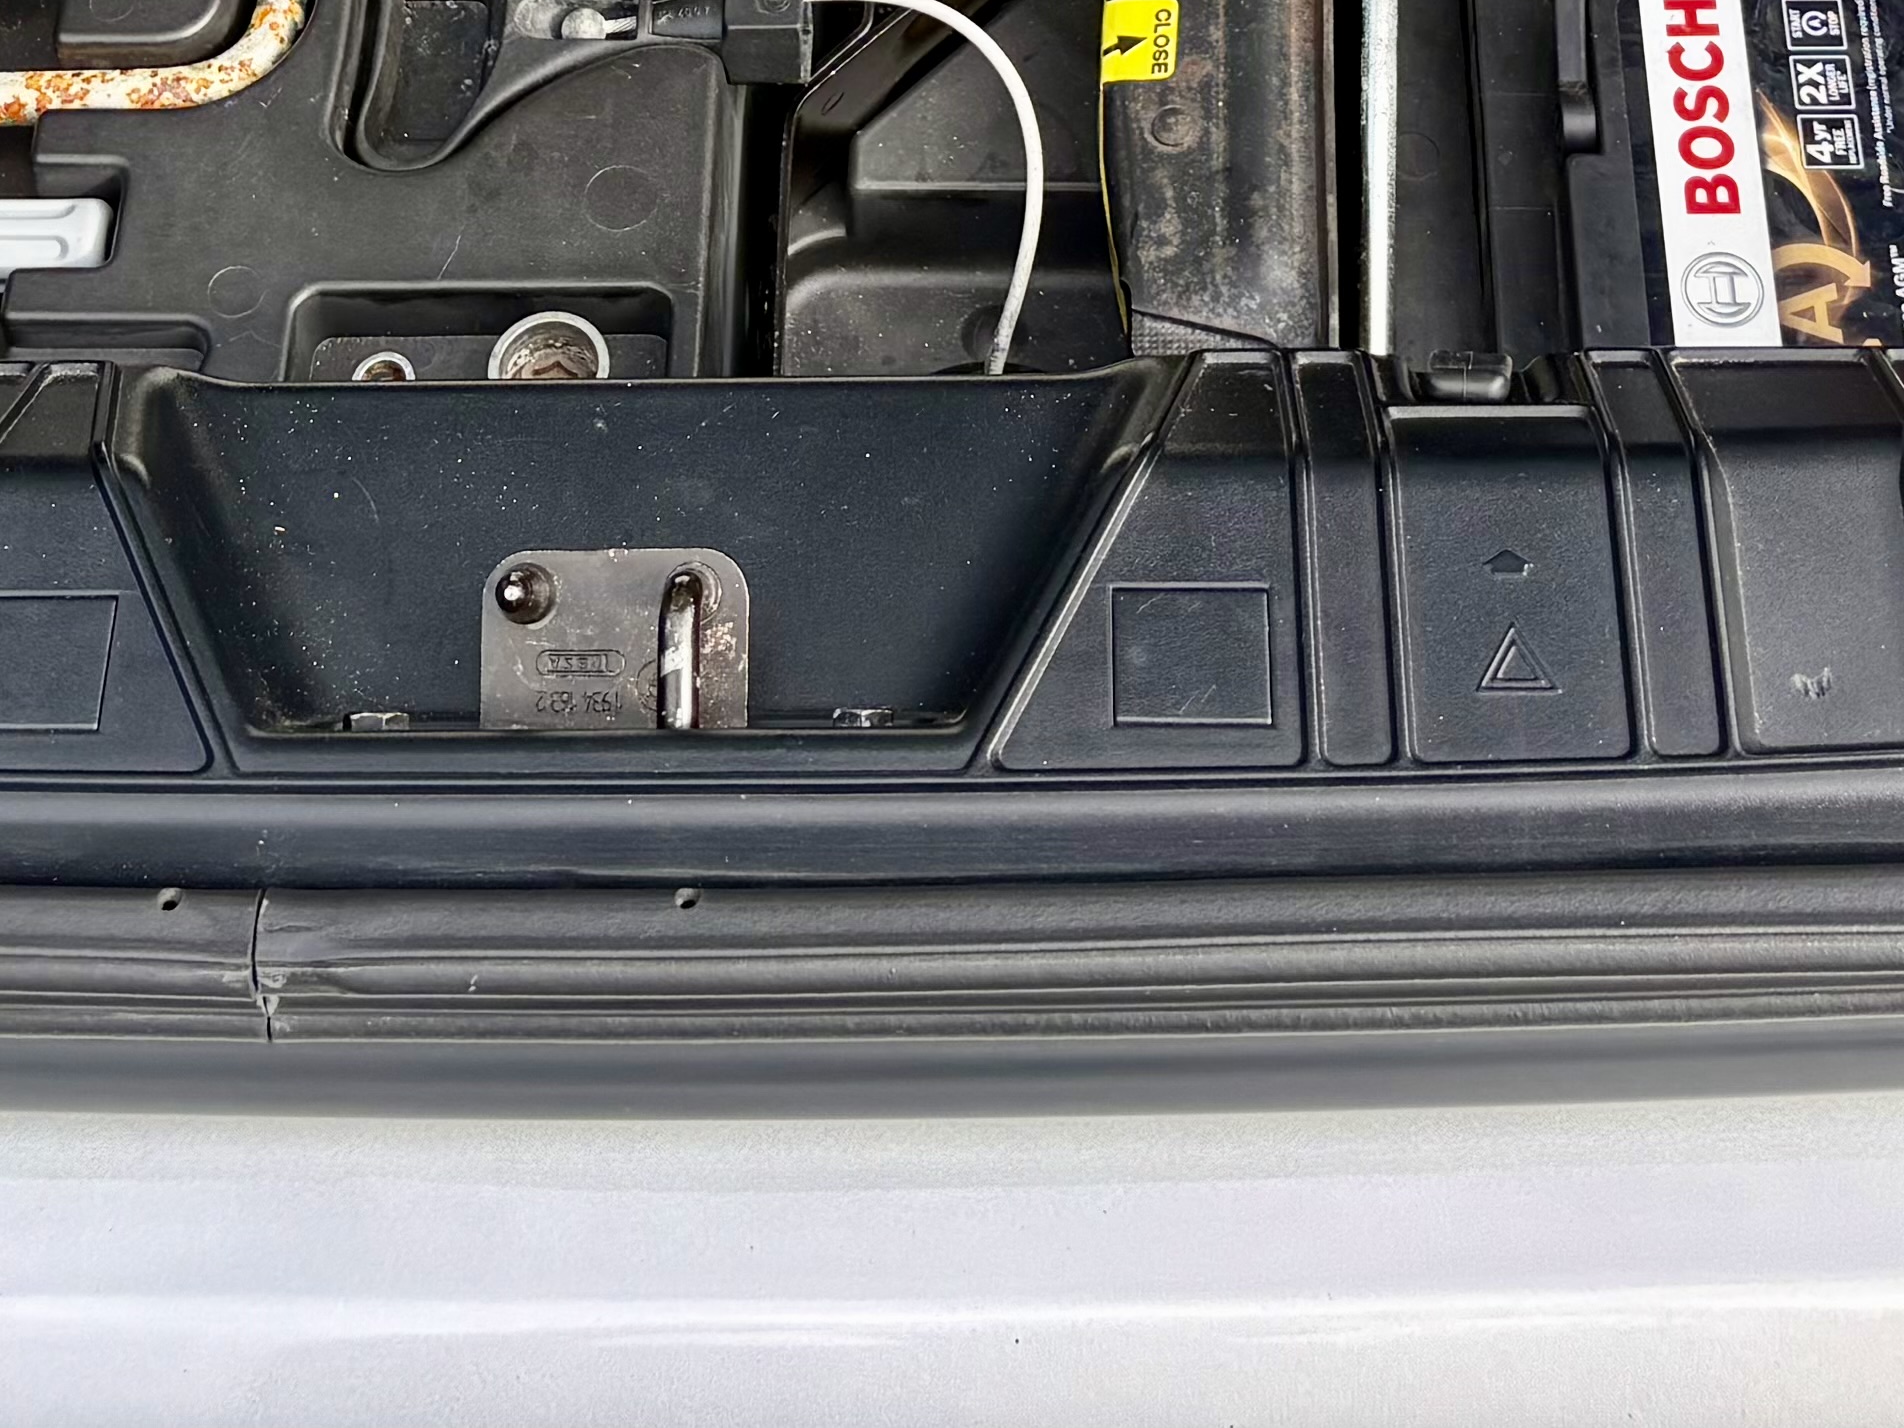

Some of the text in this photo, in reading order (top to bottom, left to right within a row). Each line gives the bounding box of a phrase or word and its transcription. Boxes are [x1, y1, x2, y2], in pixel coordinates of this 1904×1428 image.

[1150, 7, 1173, 75] CLOSE
[1789, 9, 1803, 38] START
[1827, 11, 1840, 35] STOP
[1796, 61, 1828, 104] 2X
[1825, 64, 1840, 101] LONGER
[1862, 37, 1879, 89] (registration
[1870, 90, 1884, 140] Assistance
[1832, 128, 1847, 155] FREE
[1875, 141, 1889, 183] Roadside
[1880, 185, 1894, 207] Free
